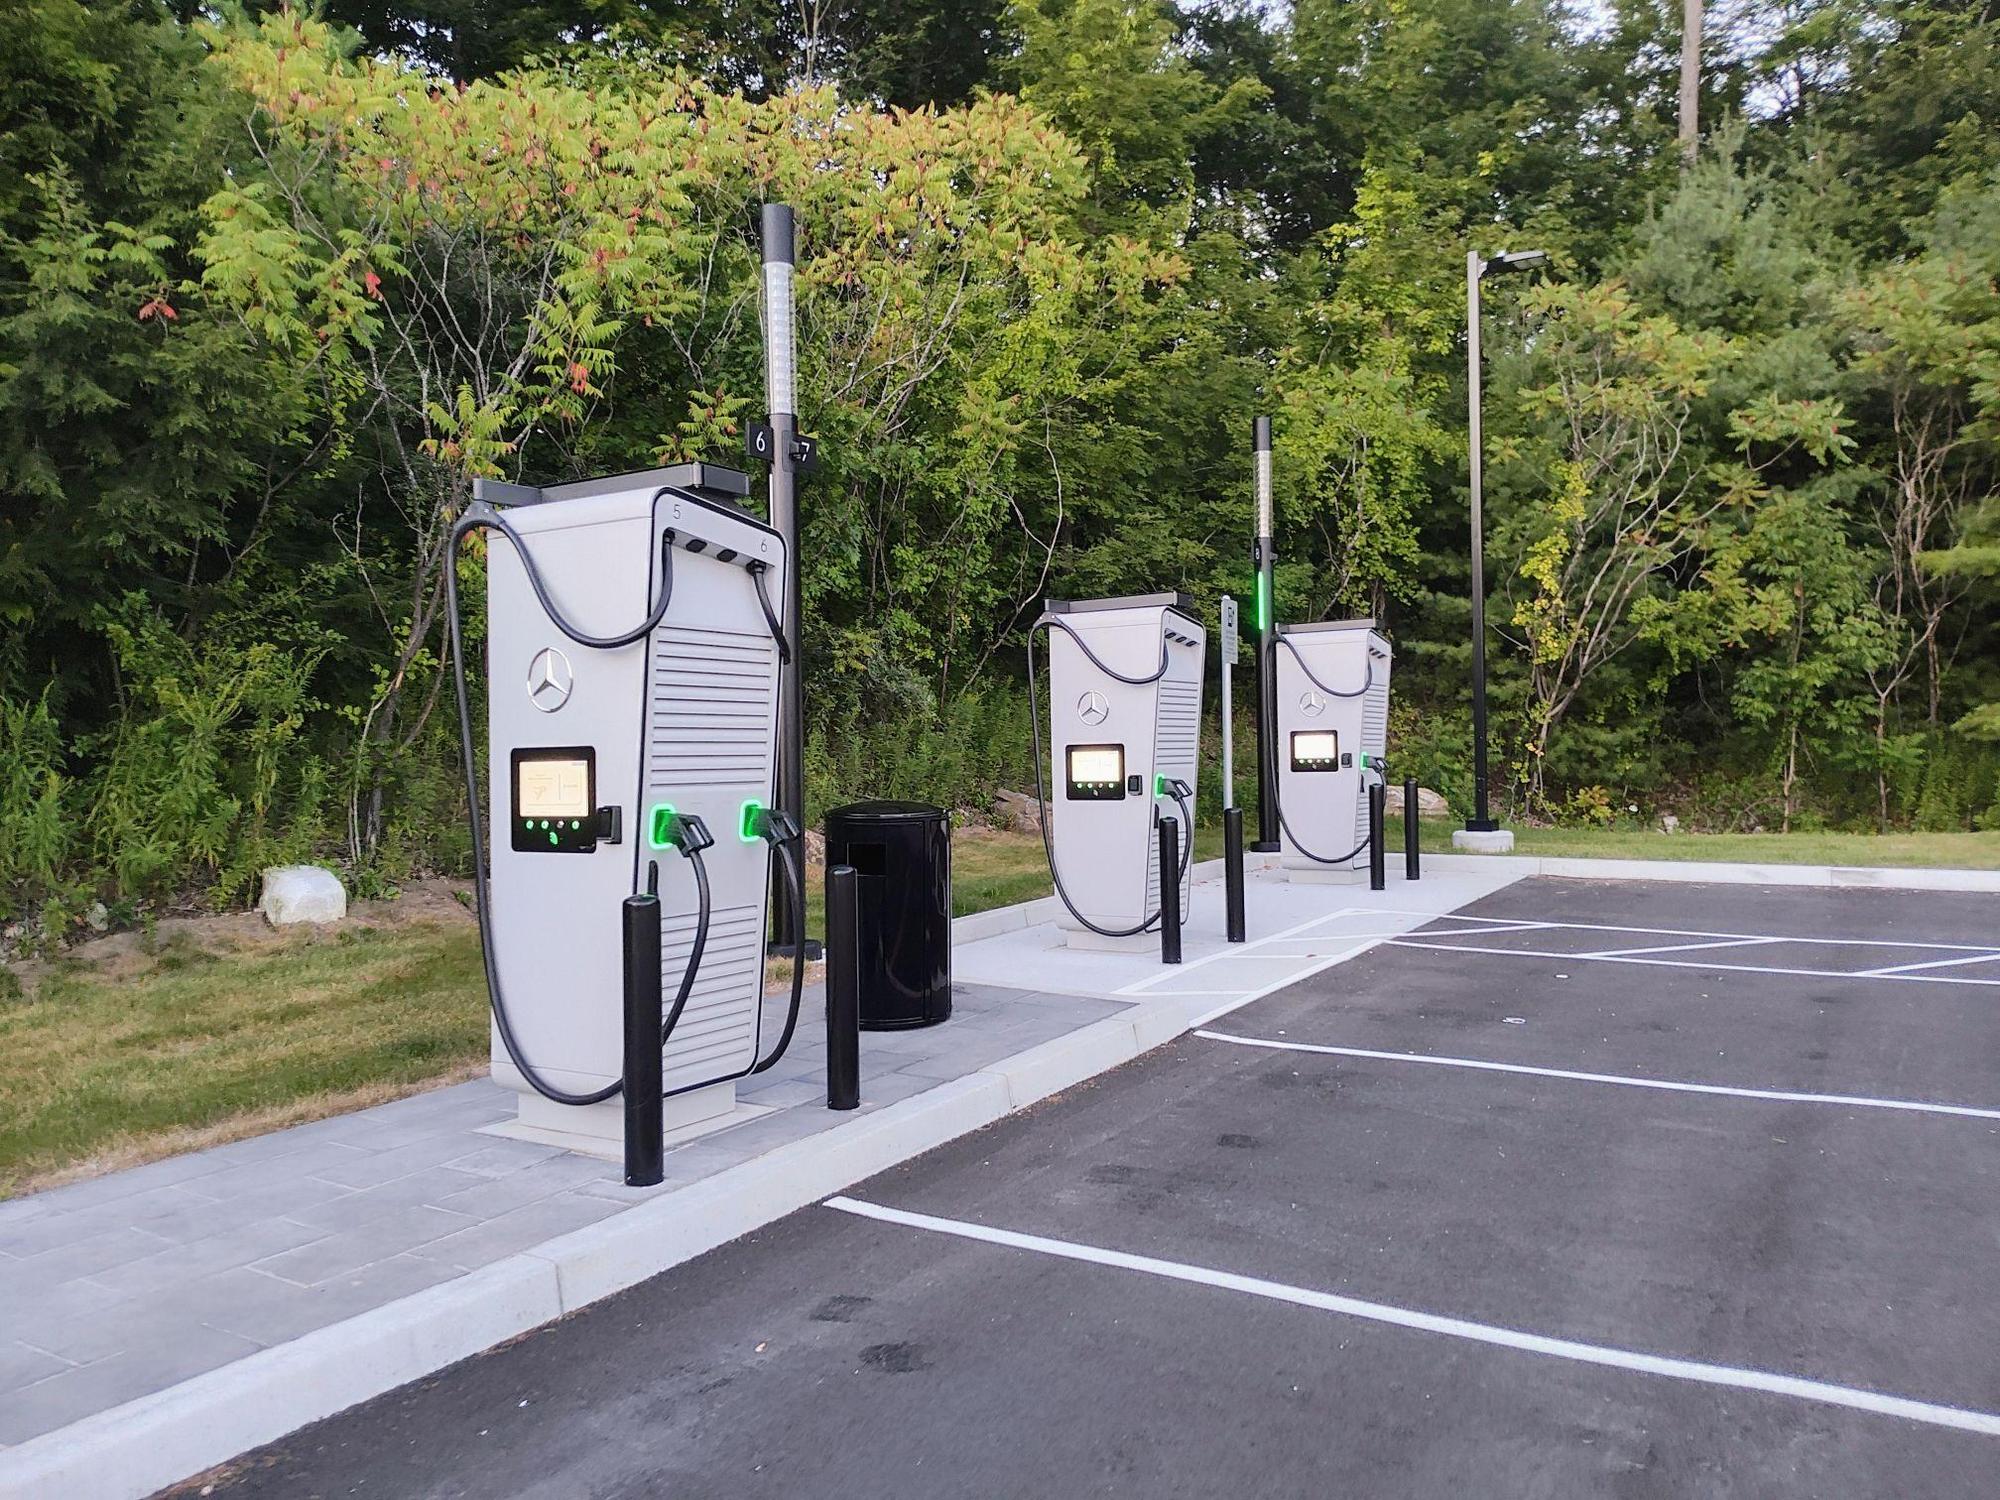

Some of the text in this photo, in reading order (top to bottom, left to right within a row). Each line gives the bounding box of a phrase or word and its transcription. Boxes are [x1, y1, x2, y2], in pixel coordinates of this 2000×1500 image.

[756, 431, 766, 452] 6
[801, 441, 810, 462] 7
[673, 504, 681, 519] 5
[761, 539, 768, 553] 6
